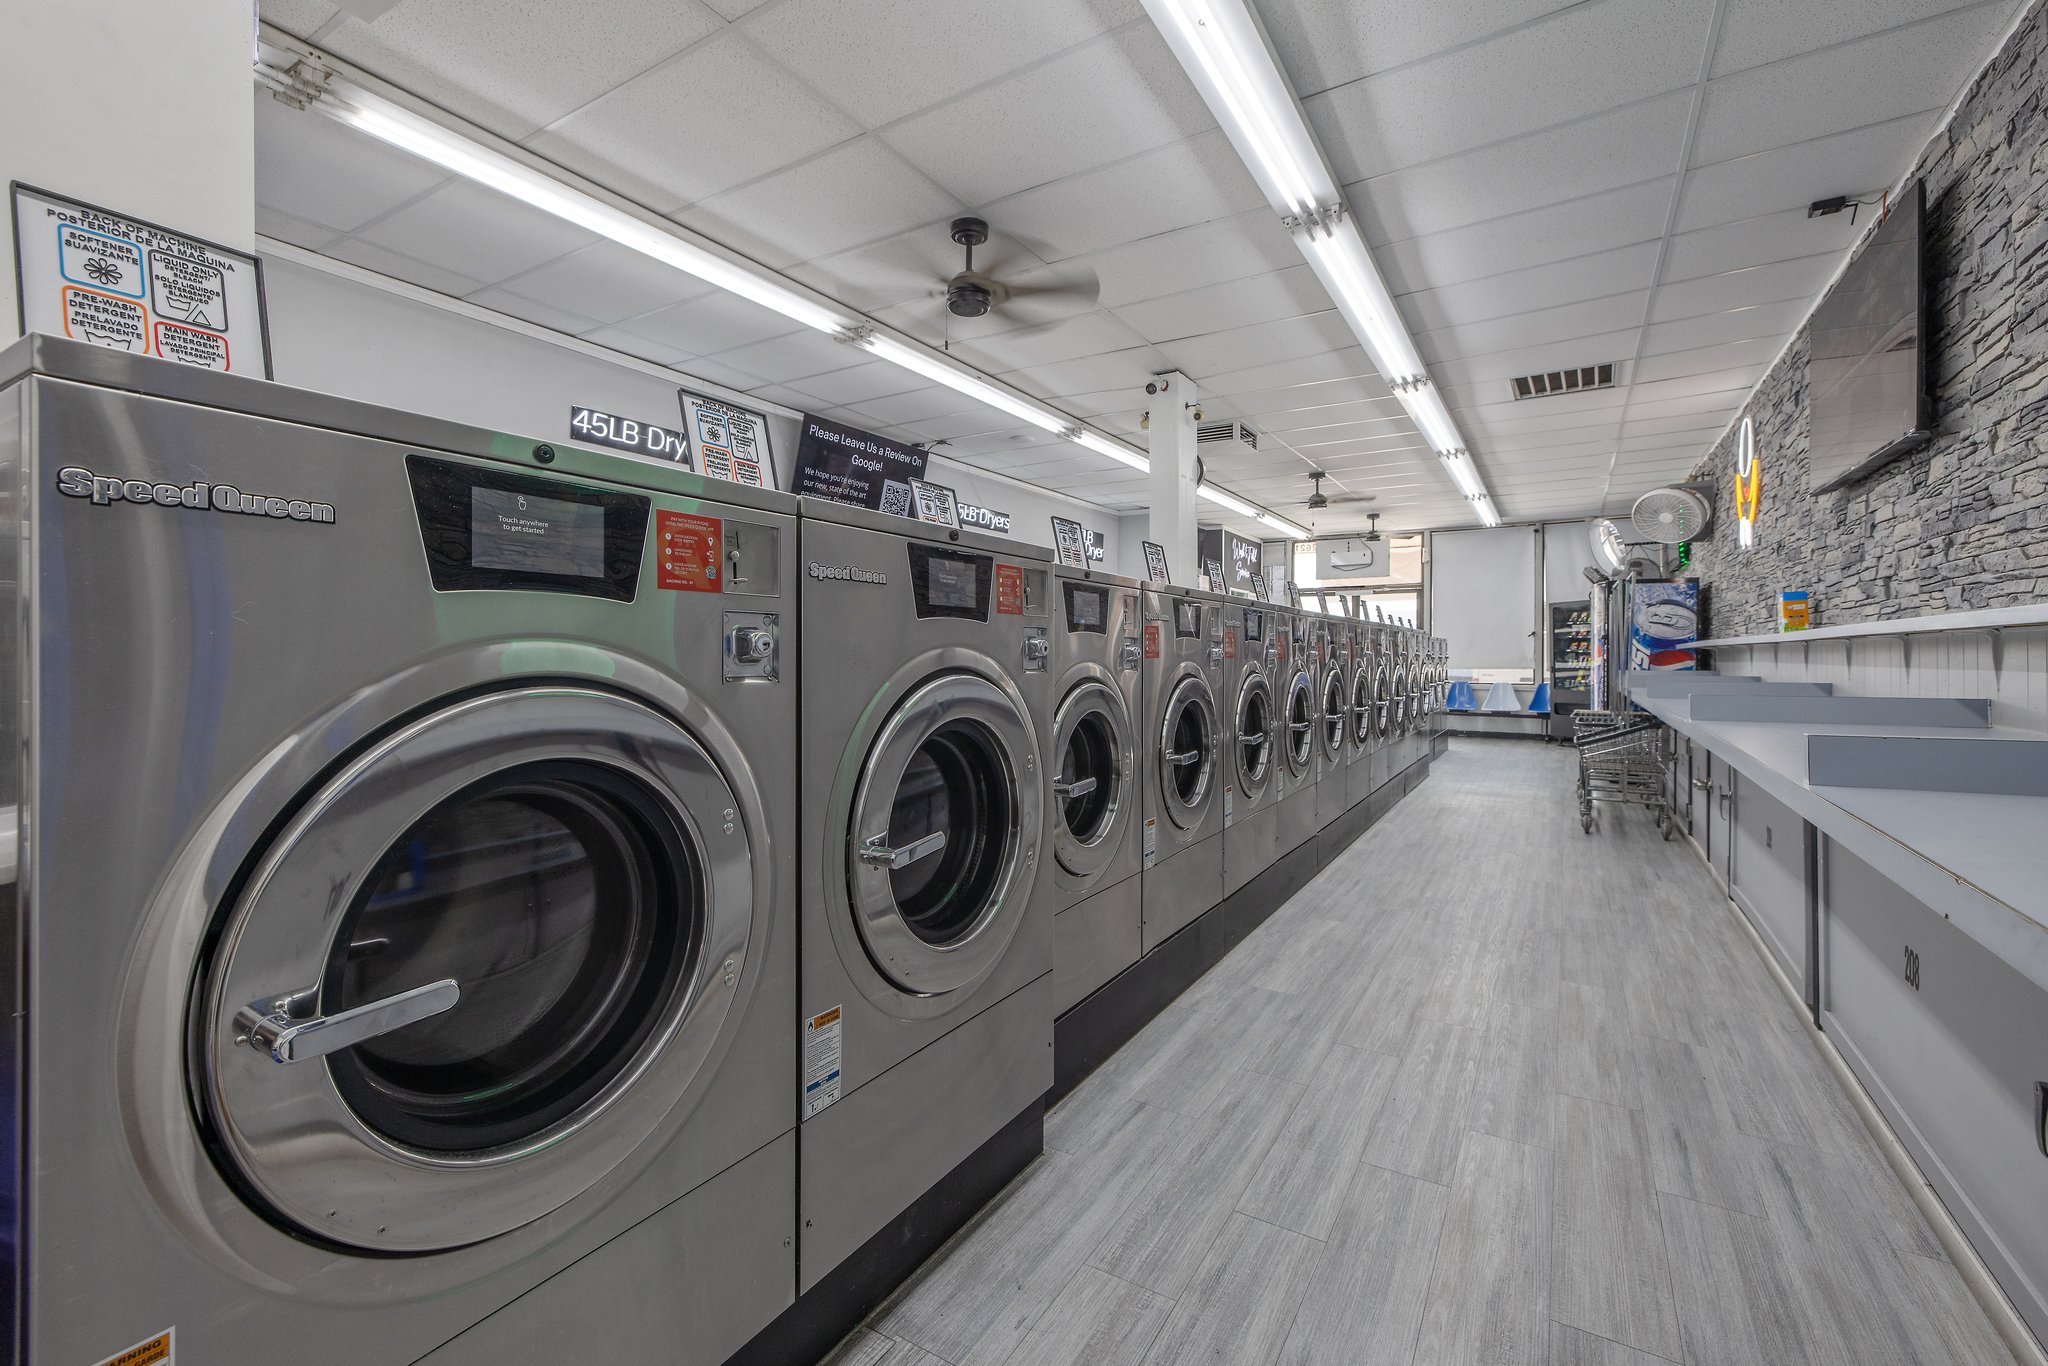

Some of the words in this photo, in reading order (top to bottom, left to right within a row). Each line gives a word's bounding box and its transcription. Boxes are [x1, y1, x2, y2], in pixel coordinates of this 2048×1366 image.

[47, 208, 131, 240] POSTERIOR
[135, 235, 153, 247] DE
[158, 241, 174, 253] LA
[178, 247, 235, 272] MAQUINA
[69, 231, 133, 255] SOFTENER
[81, 210, 122, 229] BACK
[126, 224, 143, 235] OF
[148, 230, 206, 255] MACHINE
[64, 239, 139, 265] SUAVIZANTE
[153, 254, 189, 269] LIQUID
[192, 265, 219, 278] ONLY
[155, 274, 179, 285] SOLO
[181, 281, 220, 297] LIQUIDOS
[69, 299, 142, 322] DETERGENT
[73, 291, 137, 313] PRE-WASH
[71, 318, 143, 340] DETERGENTE
[74, 311, 138, 331] PRELAVADO
[163, 332, 221, 351] DETERGENT
[164, 326, 188, 336] MAIN
[191, 331, 219, 343] WASH
[160, 339, 189, 350] LAVADO
[190, 347, 225, 360] PRINCIPAL
[170, 347, 217, 362] DETERGENTE
[572, 409, 639, 445] 45LB
[647, 426, 687, 461] Dry
[809, 424, 840, 442] Please
[841, 434, 866, 450] Leave
[867, 441, 878, 454] Us
[878, 447, 884, 456] a
[885, 447, 912, 463] Review
[911, 455, 922, 467] On
[852, 454, 884, 472] Google!
[803, 479, 814, 487] our
[815, 482, 828, 491] new,
[829, 484, 842, 494] state
[843, 488, 850, 496] of
[850, 490, 859, 498] the
[804, 466, 815, 476] We
[815, 470, 830, 480] hope
[830, 473, 847, 484] you're
[847, 478, 870, 491] enjoying
[57, 466, 211, 511] Speed
[211, 484, 336, 525] Queen
[498, 514, 518, 524] Touch
[519, 519, 549, 528] anywhere
[979, 508, 1010, 529] Dryers
[523, 527, 545, 535] started
[1081, 529, 1094, 544] LB
[1904, 945, 1920, 992] 208
[108, 1340, 161, 1366] ARNING
